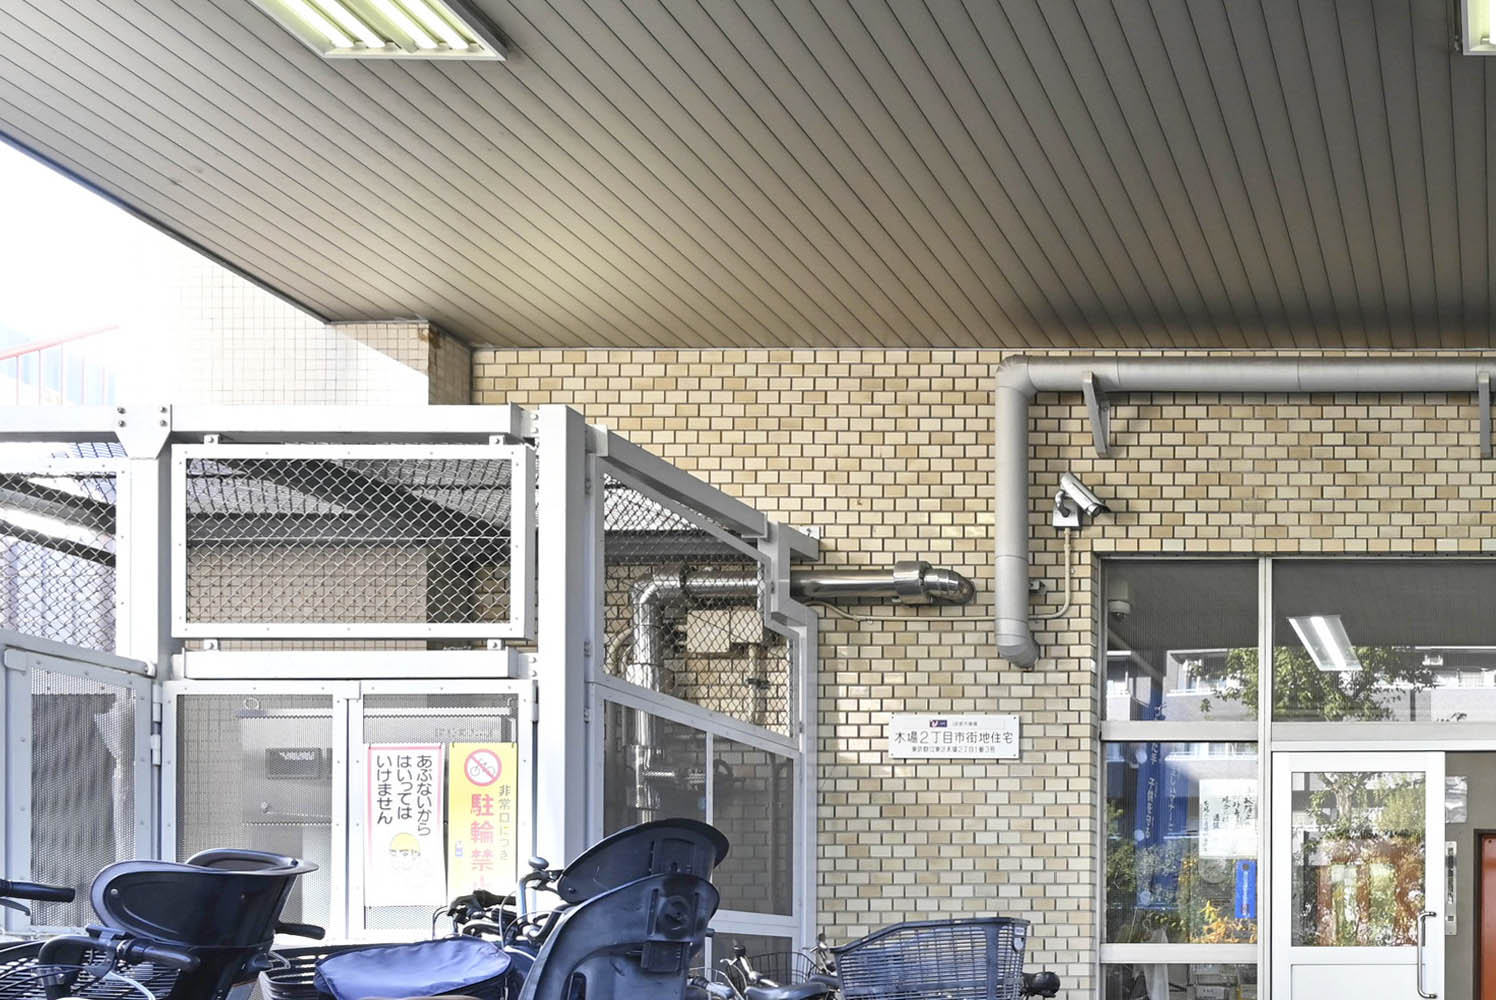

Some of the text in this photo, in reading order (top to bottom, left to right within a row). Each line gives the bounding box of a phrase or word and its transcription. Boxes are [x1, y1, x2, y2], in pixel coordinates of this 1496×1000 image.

[895, 731, 1013, 744] 木場2丁目市街地住宅
[376, 754, 392, 825] いけません
[396, 754, 412, 820] はいっては
[416, 754, 432, 836] あぶないから
[498, 784, 511, 861] 非常口につき
